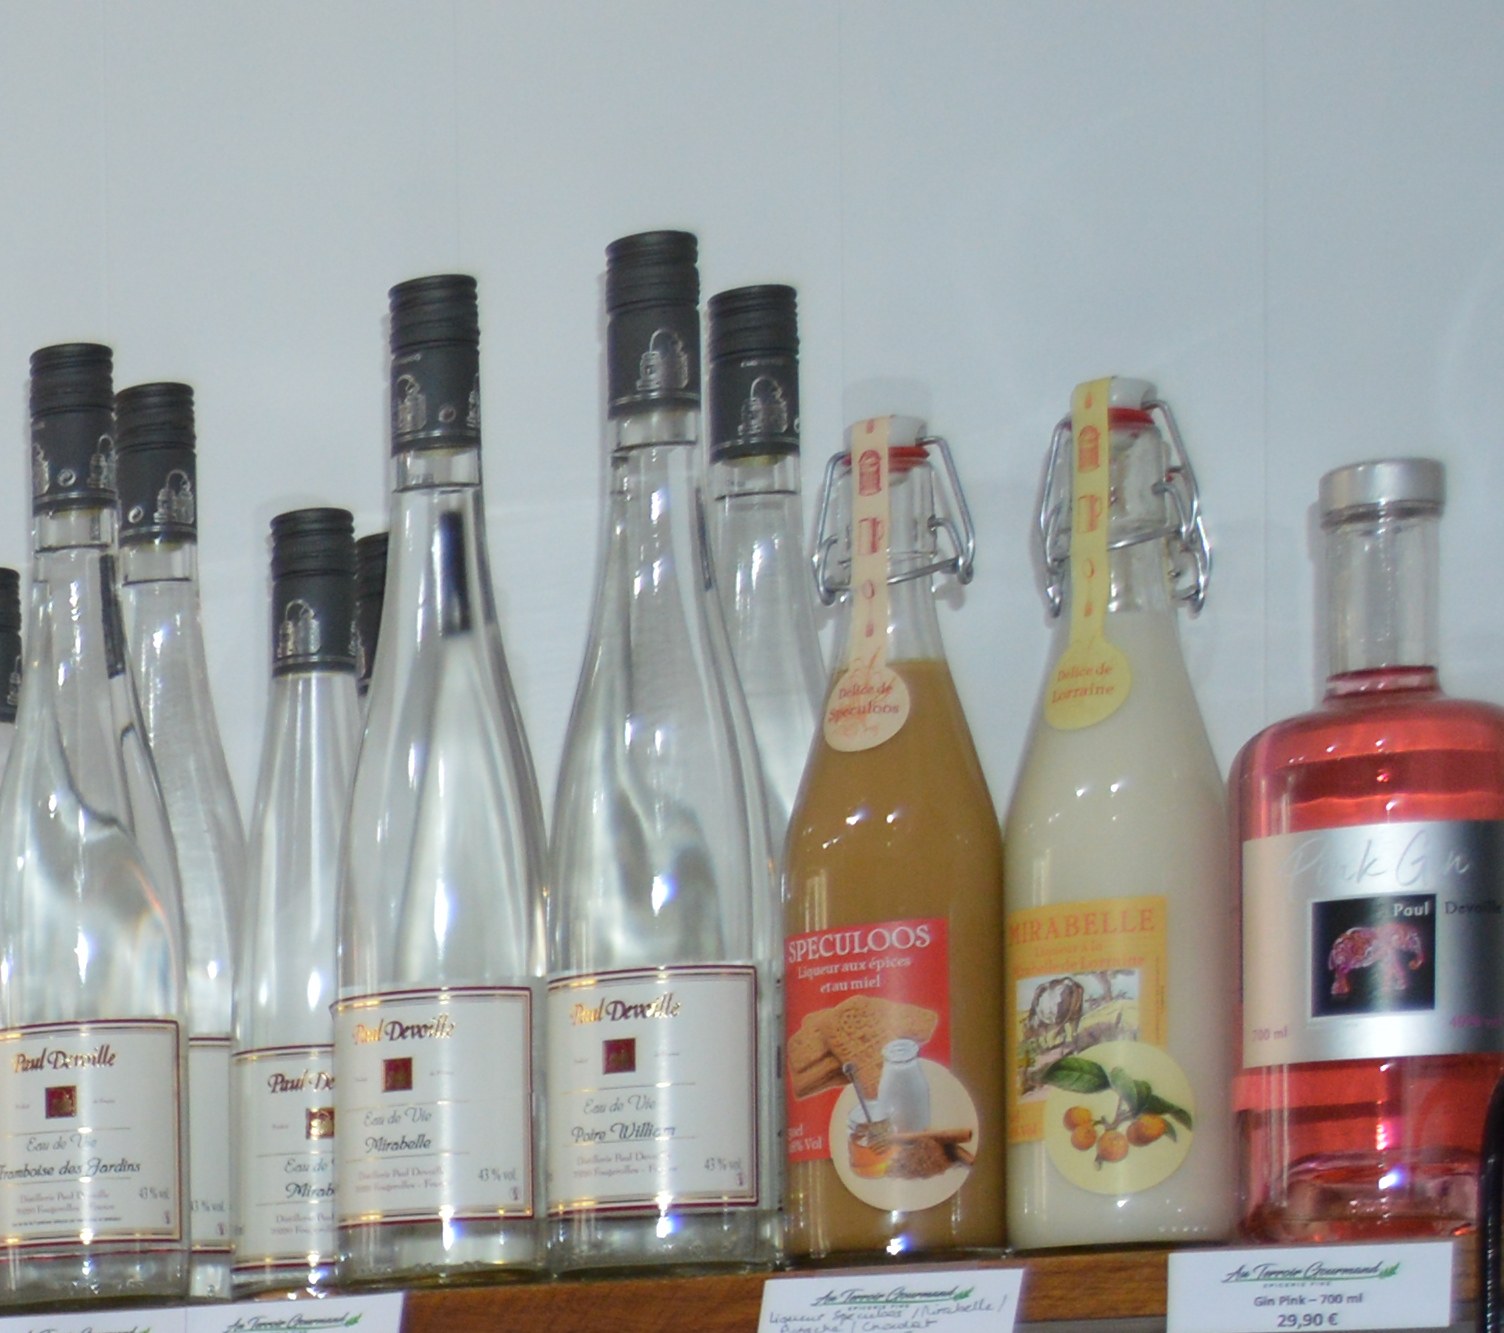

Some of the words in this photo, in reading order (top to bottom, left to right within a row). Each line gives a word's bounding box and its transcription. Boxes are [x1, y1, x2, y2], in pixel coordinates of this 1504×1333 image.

[1052, 682, 1114, 703] Lorraine
[1393, 902, 1429, 916] Paul
[1009, 908, 1156, 945] MIRABELLE
[788, 924, 931, 964] SPECULOOS
[798, 963, 839, 980] Liqueur
[842, 961, 866, 972] aux
[869, 956, 912, 972] épices
[831, 981, 848, 991] au
[851, 976, 881, 989] miel
[570, 998, 605, 1025] Paul
[605, 992, 682, 1022] Devoille
[352, 1019, 384, 1044] Paul
[385, 1013, 456, 1041] Devoille
[13, 1048, 47, 1073] Paul
[268, 1069, 308, 1094] Paul
[584, 1100, 605, 1114] Eau
[609, 1098, 624, 1112] de
[627, 1095, 656, 1111] Vie
[364, 1111, 385, 1127] Eau
[387, 1109, 402, 1124] de
[404, 1107, 432, 1123] Vie
[26, 1137, 49, 1151] Eau
[53, 1136, 67, 1150] de
[365, 1134, 431, 1153] Mirabelle
[571, 1126, 606, 1143] Poire
[59, 1160, 82, 1175] des
[84, 1157, 141, 1178] Jardins
[284, 1159, 309, 1173] Eau
[1221, 1265, 1250, 1283] Au
[1252, 1263, 1303, 1279] Terroir
[1304, 1261, 1384, 1279] Gourmand
[811, 1290, 838, 1307] Au
[839, 1289, 885, 1300] Terroir
[887, 1286, 959, 1303] Gourmand
[1253, 1297, 1275, 1307] Gin
[1278, 1295, 1306, 1306] Pink
[1320, 1294, 1343, 1304] 700
[1346, 1293, 1364, 1303] ml
[247, 1316, 286, 1330] Terroir
[287, 1312, 350, 1329] Gourmand
[769, 1311, 825, 1324] Liqueur
[1277, 1313, 1324, 1330] 29,90
[1328, 1312, 1339, 1325] €
